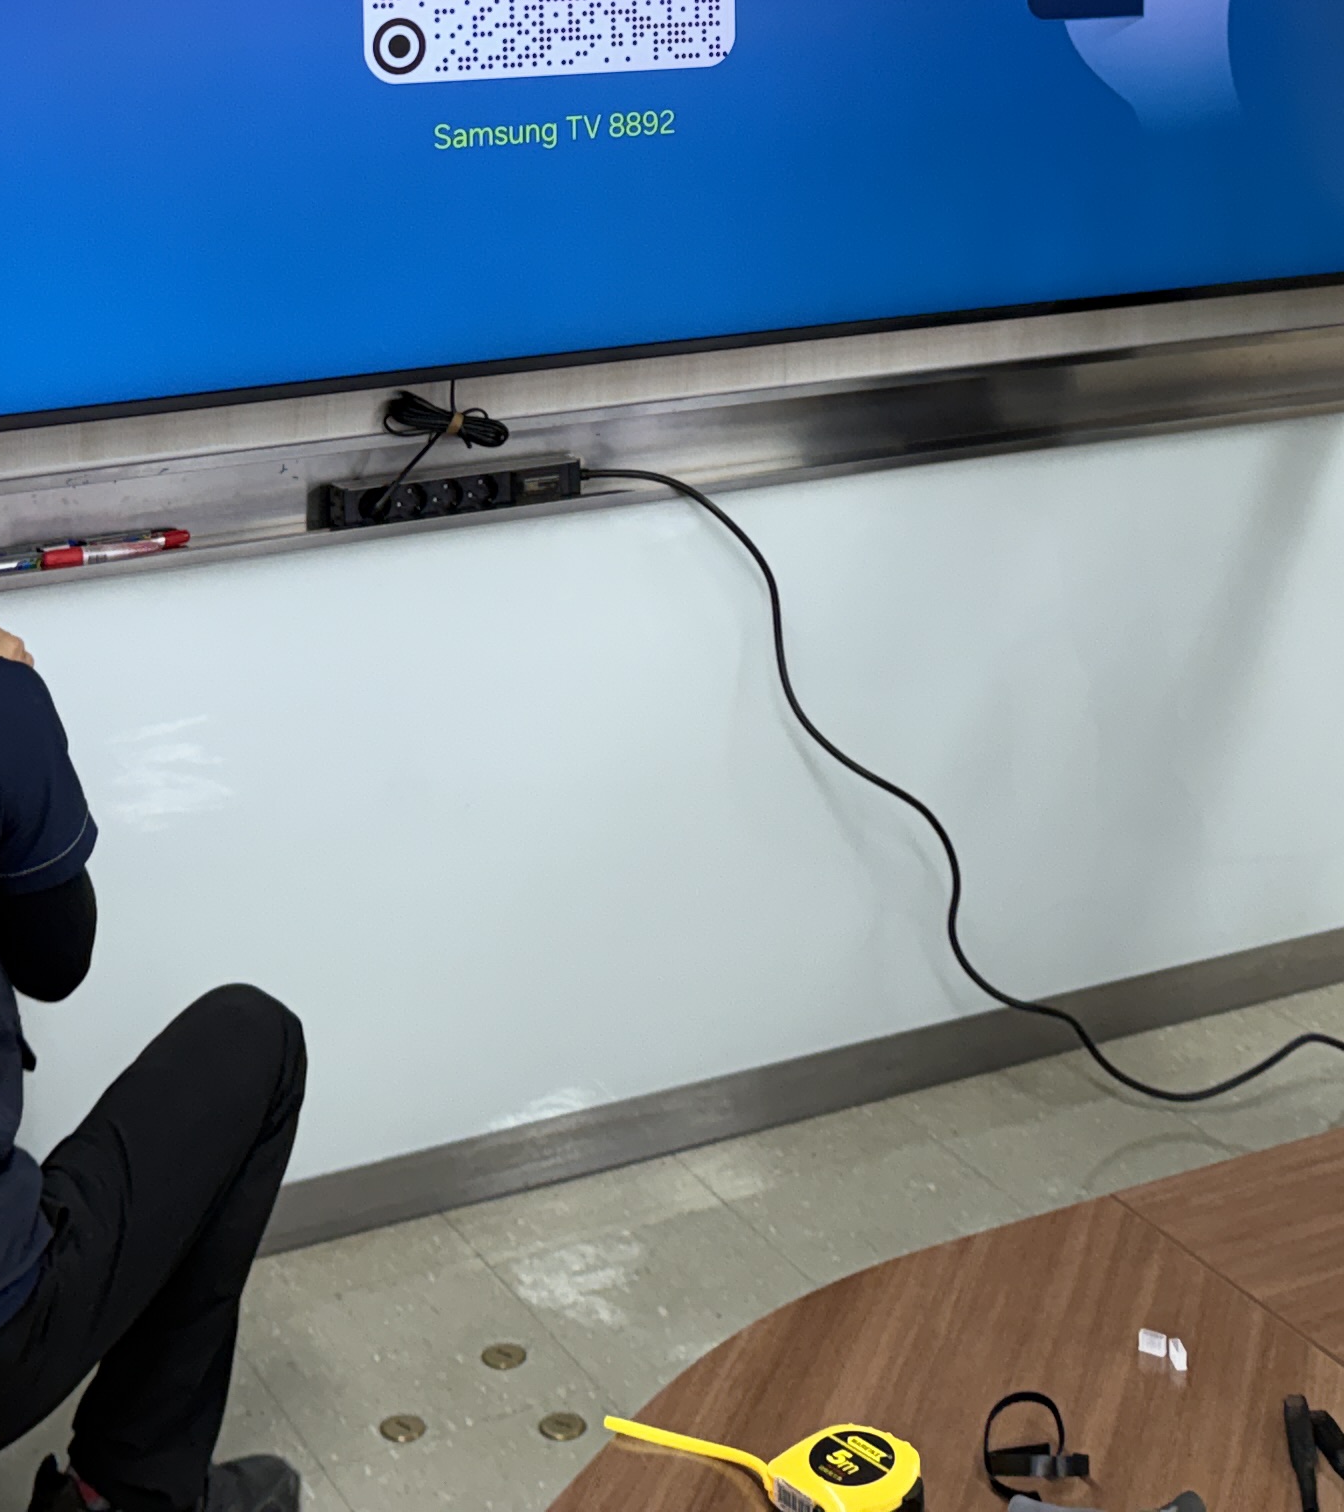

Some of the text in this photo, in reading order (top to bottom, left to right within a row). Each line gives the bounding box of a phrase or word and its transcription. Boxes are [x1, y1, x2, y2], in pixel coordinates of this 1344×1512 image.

[434, 109, 675, 150] Samsung TV 8892
[826, 1449, 859, 1475] 5m
